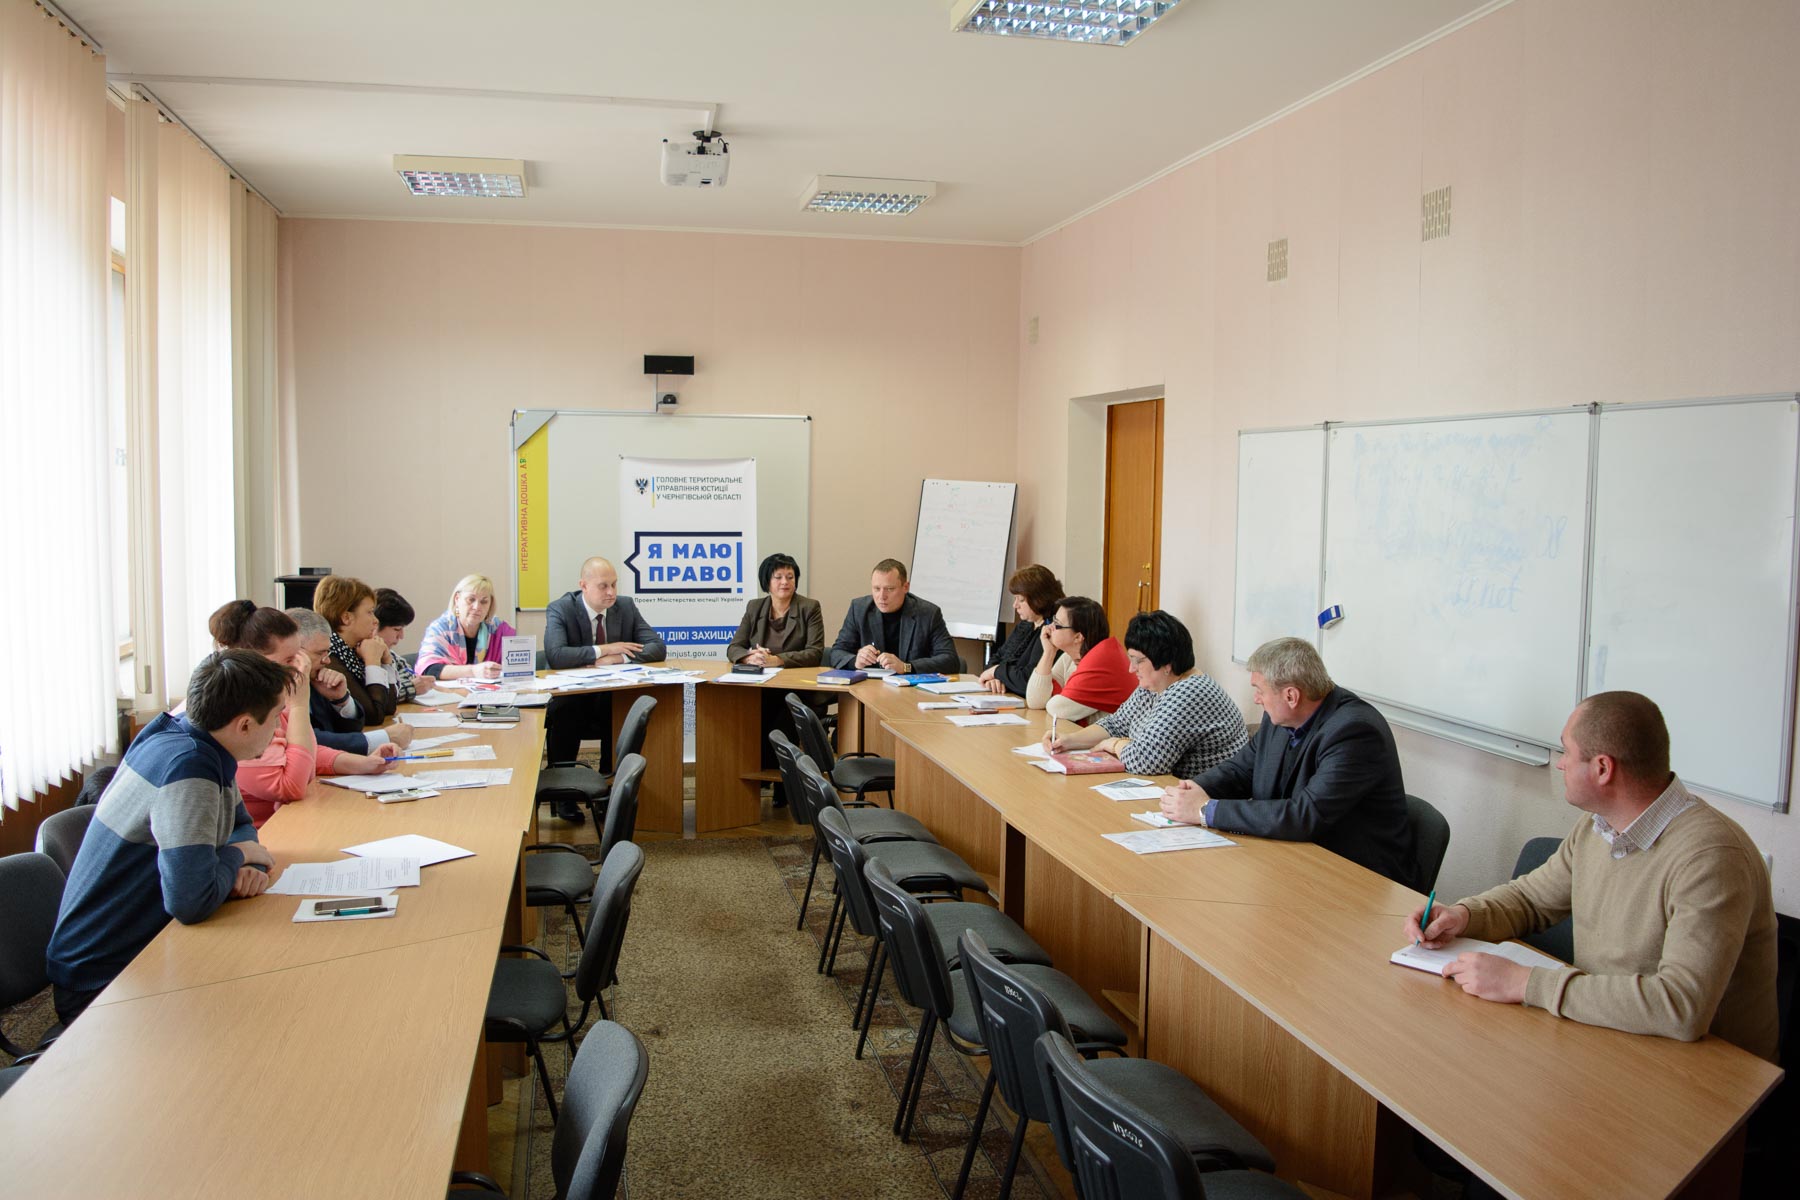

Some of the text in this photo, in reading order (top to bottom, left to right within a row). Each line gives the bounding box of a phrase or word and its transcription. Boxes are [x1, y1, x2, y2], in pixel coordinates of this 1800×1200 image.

[656, 476, 743, 484] ГОЛОВНЕ ТЕРИТОРІАЛЬНЕ
[700, 484, 729, 493] ЮСТИЦІЇ
[656, 492, 742, 501] У ЧЕРНІГІВСЬКІЙ ОБЛАСТІ
[520, 472, 529, 572] ІНТЕРАКТИВНА ДОШКА
[647, 543, 732, 559] Я МАЮ
[667, 630, 690, 642] ДІЮ!
[691, 630, 737, 641] ЗАХИЩА
